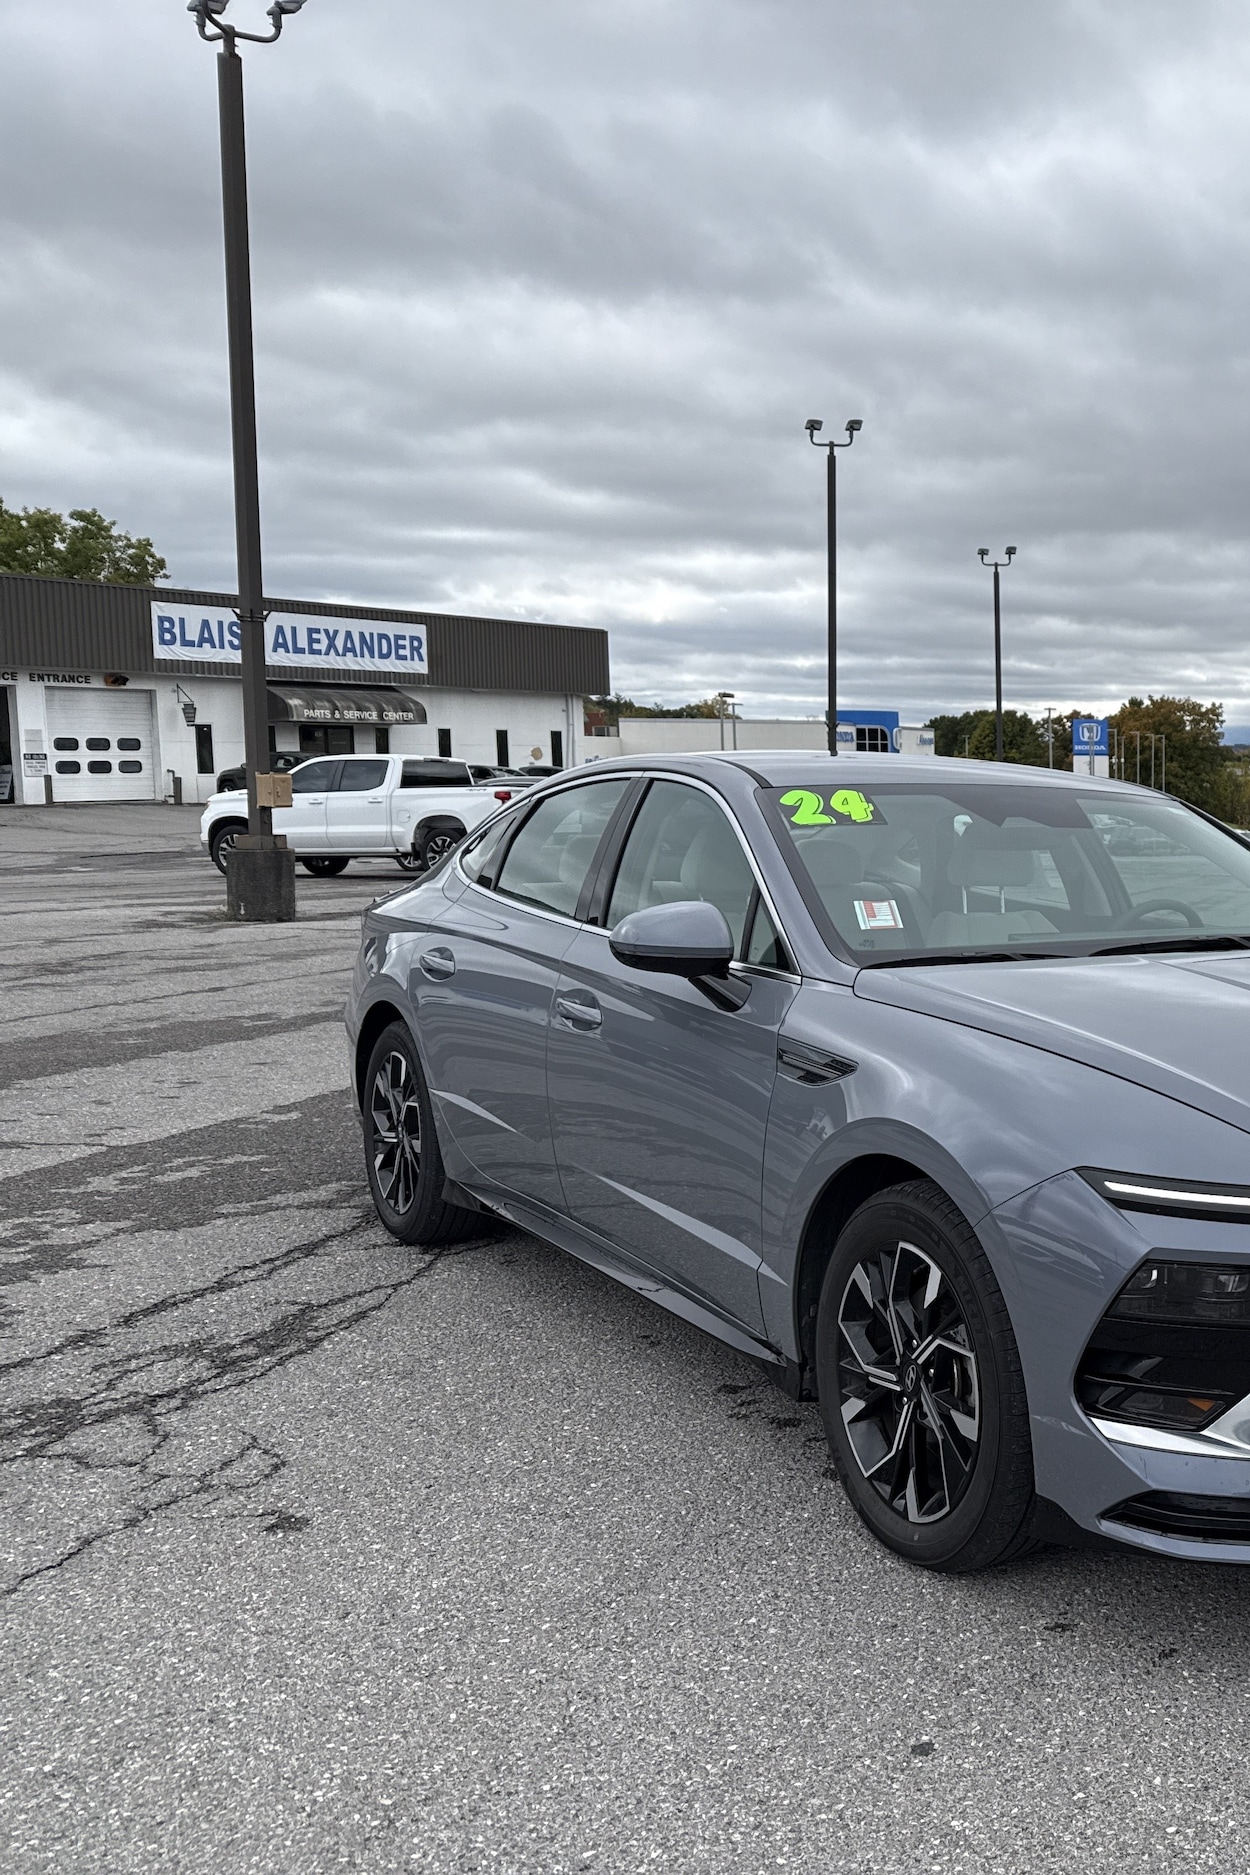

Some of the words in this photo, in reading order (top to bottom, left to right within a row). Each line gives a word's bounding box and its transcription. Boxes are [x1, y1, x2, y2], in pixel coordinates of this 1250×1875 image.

[157, 615, 242, 651] BLAIS
[271, 624, 425, 662] ALEXANDER
[28, 672, 92, 684] ENTRANCE
[303, 708, 331, 719] PARTS
[334, 709, 340, 719] &
[343, 710, 378, 720] SERVICE
[382, 711, 414, 720] CENTER
[779, 789, 875, 826] 24
